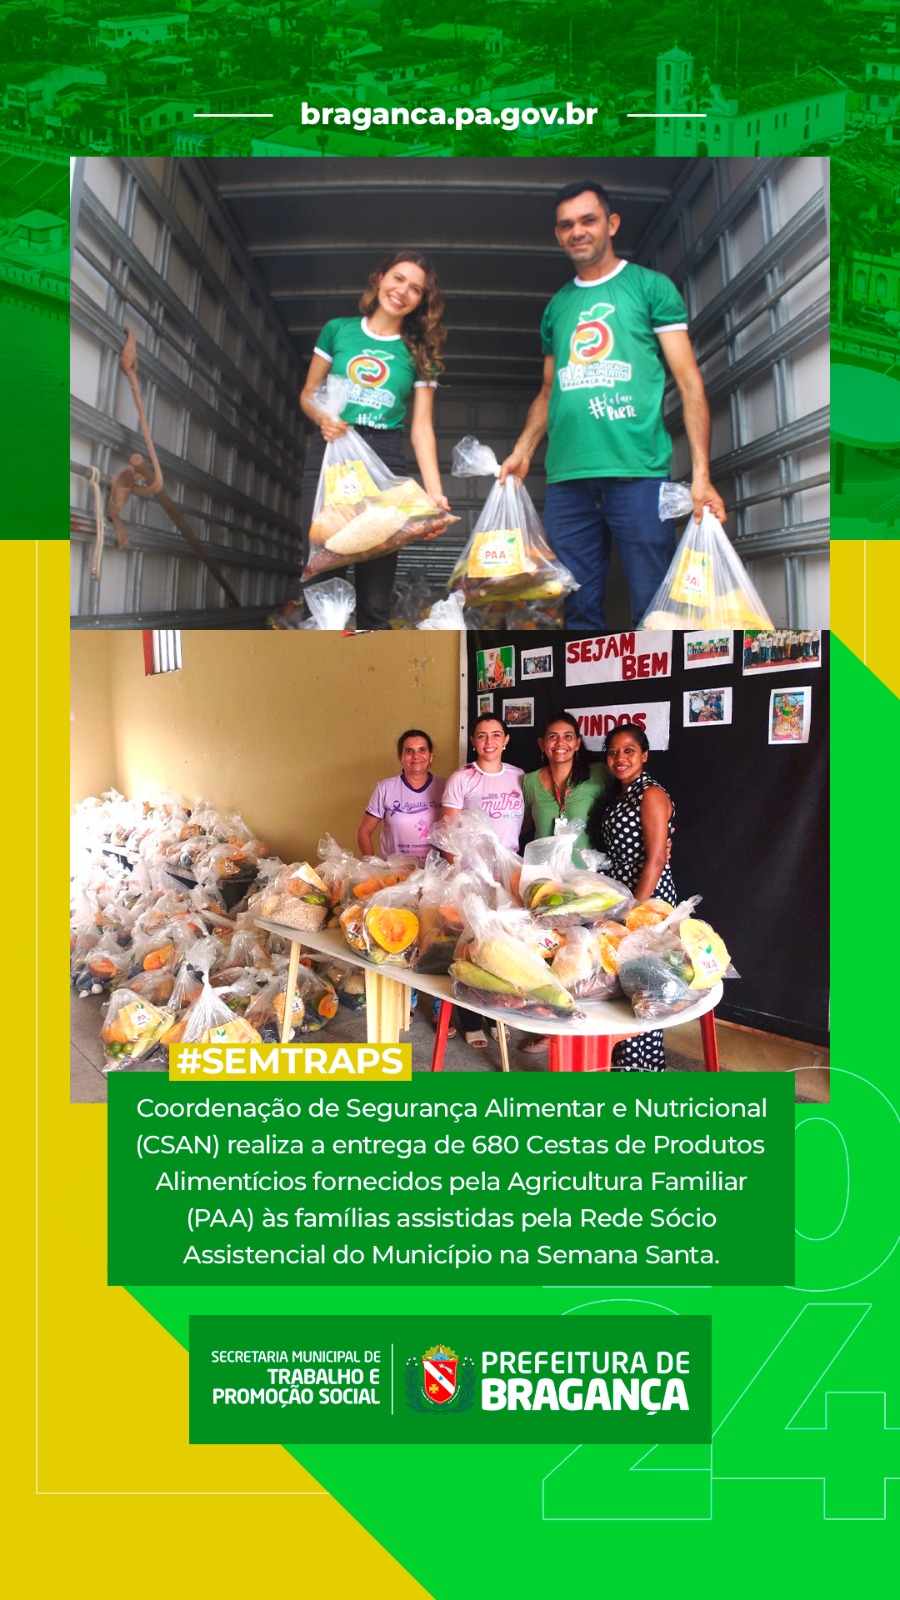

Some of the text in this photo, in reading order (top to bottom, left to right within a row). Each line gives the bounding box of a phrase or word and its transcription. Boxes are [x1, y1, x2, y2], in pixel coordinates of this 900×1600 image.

[485, 550, 506, 560] PAA
[566, 632, 636, 664] SEJAM
[621, 651, 669, 680] BEM
